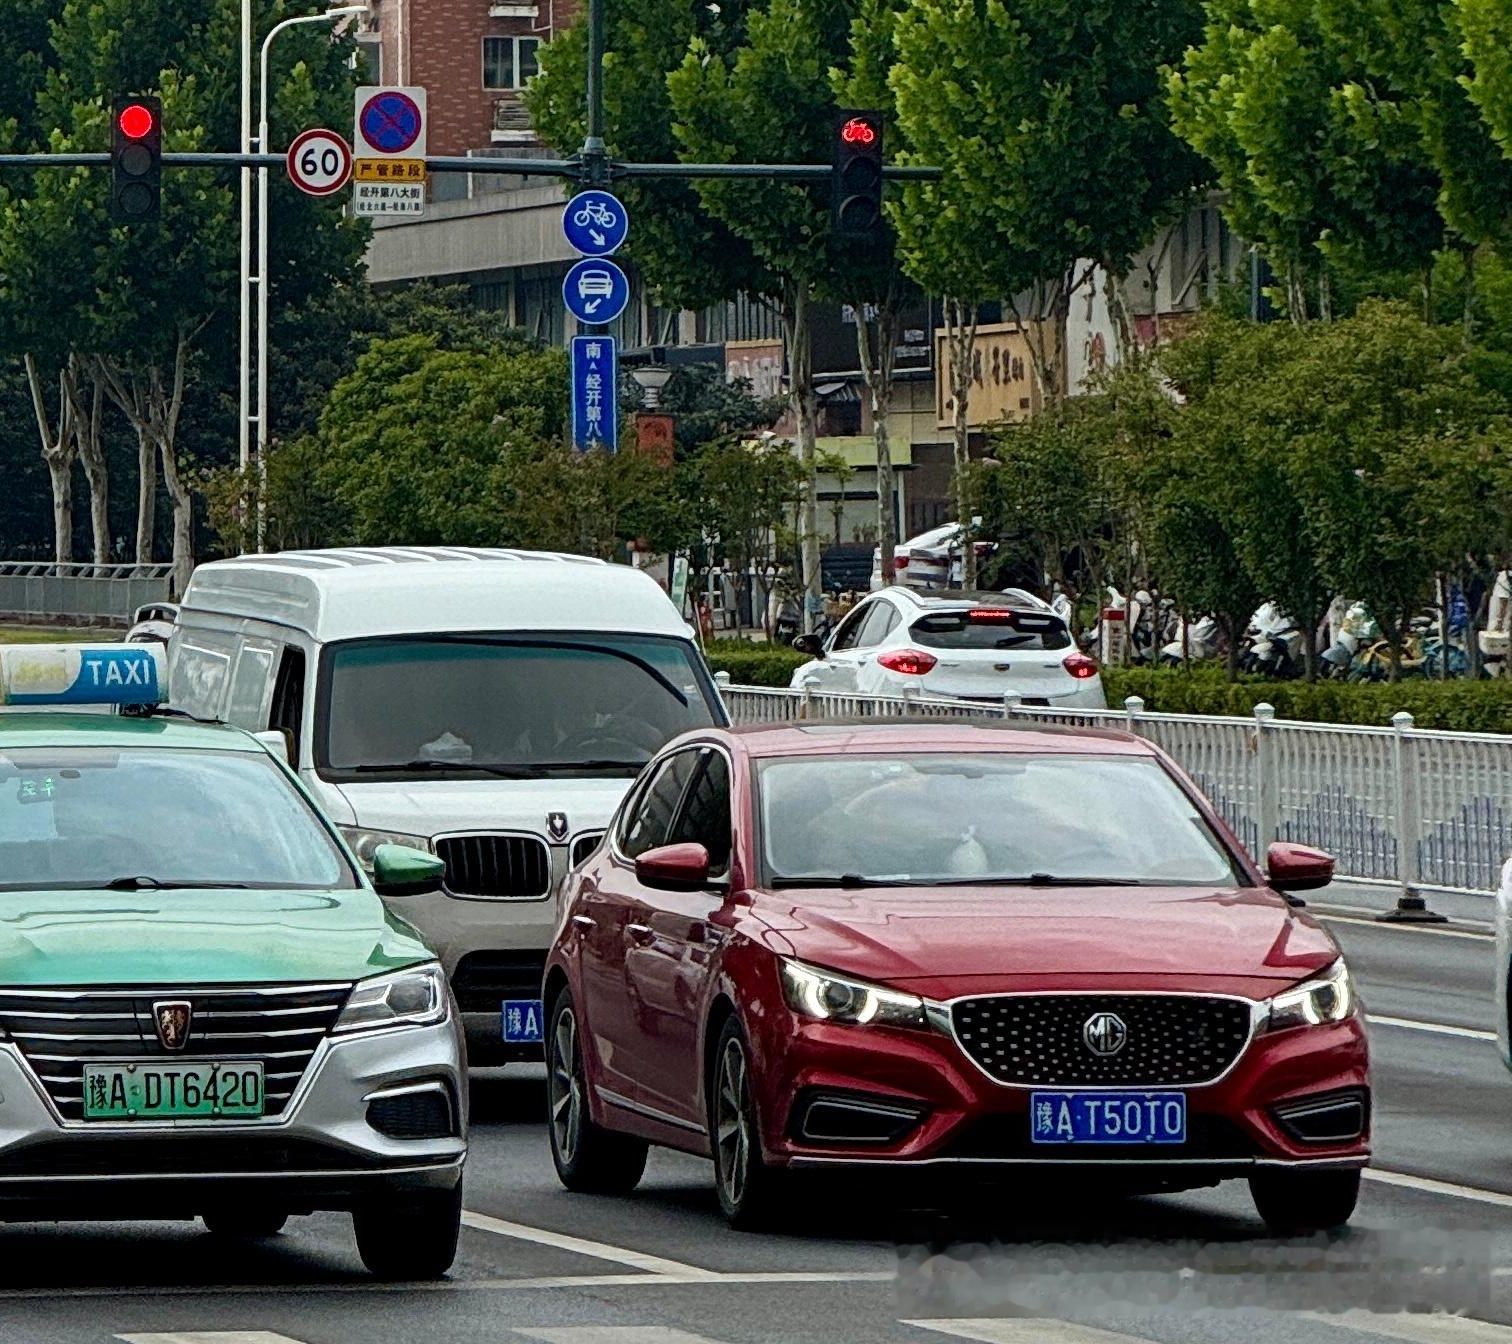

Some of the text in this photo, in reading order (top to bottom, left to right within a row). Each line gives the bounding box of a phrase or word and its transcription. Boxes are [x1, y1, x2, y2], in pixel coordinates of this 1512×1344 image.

[301, 148, 339, 176] 60
[360, 163, 421, 177] 严管路段
[359, 187, 420, 199] 经开第八大街
[585, 342, 602, 359] 南
[87, 659, 151, 686] TAXI
[1088, 1016, 1125, 1052] MG
